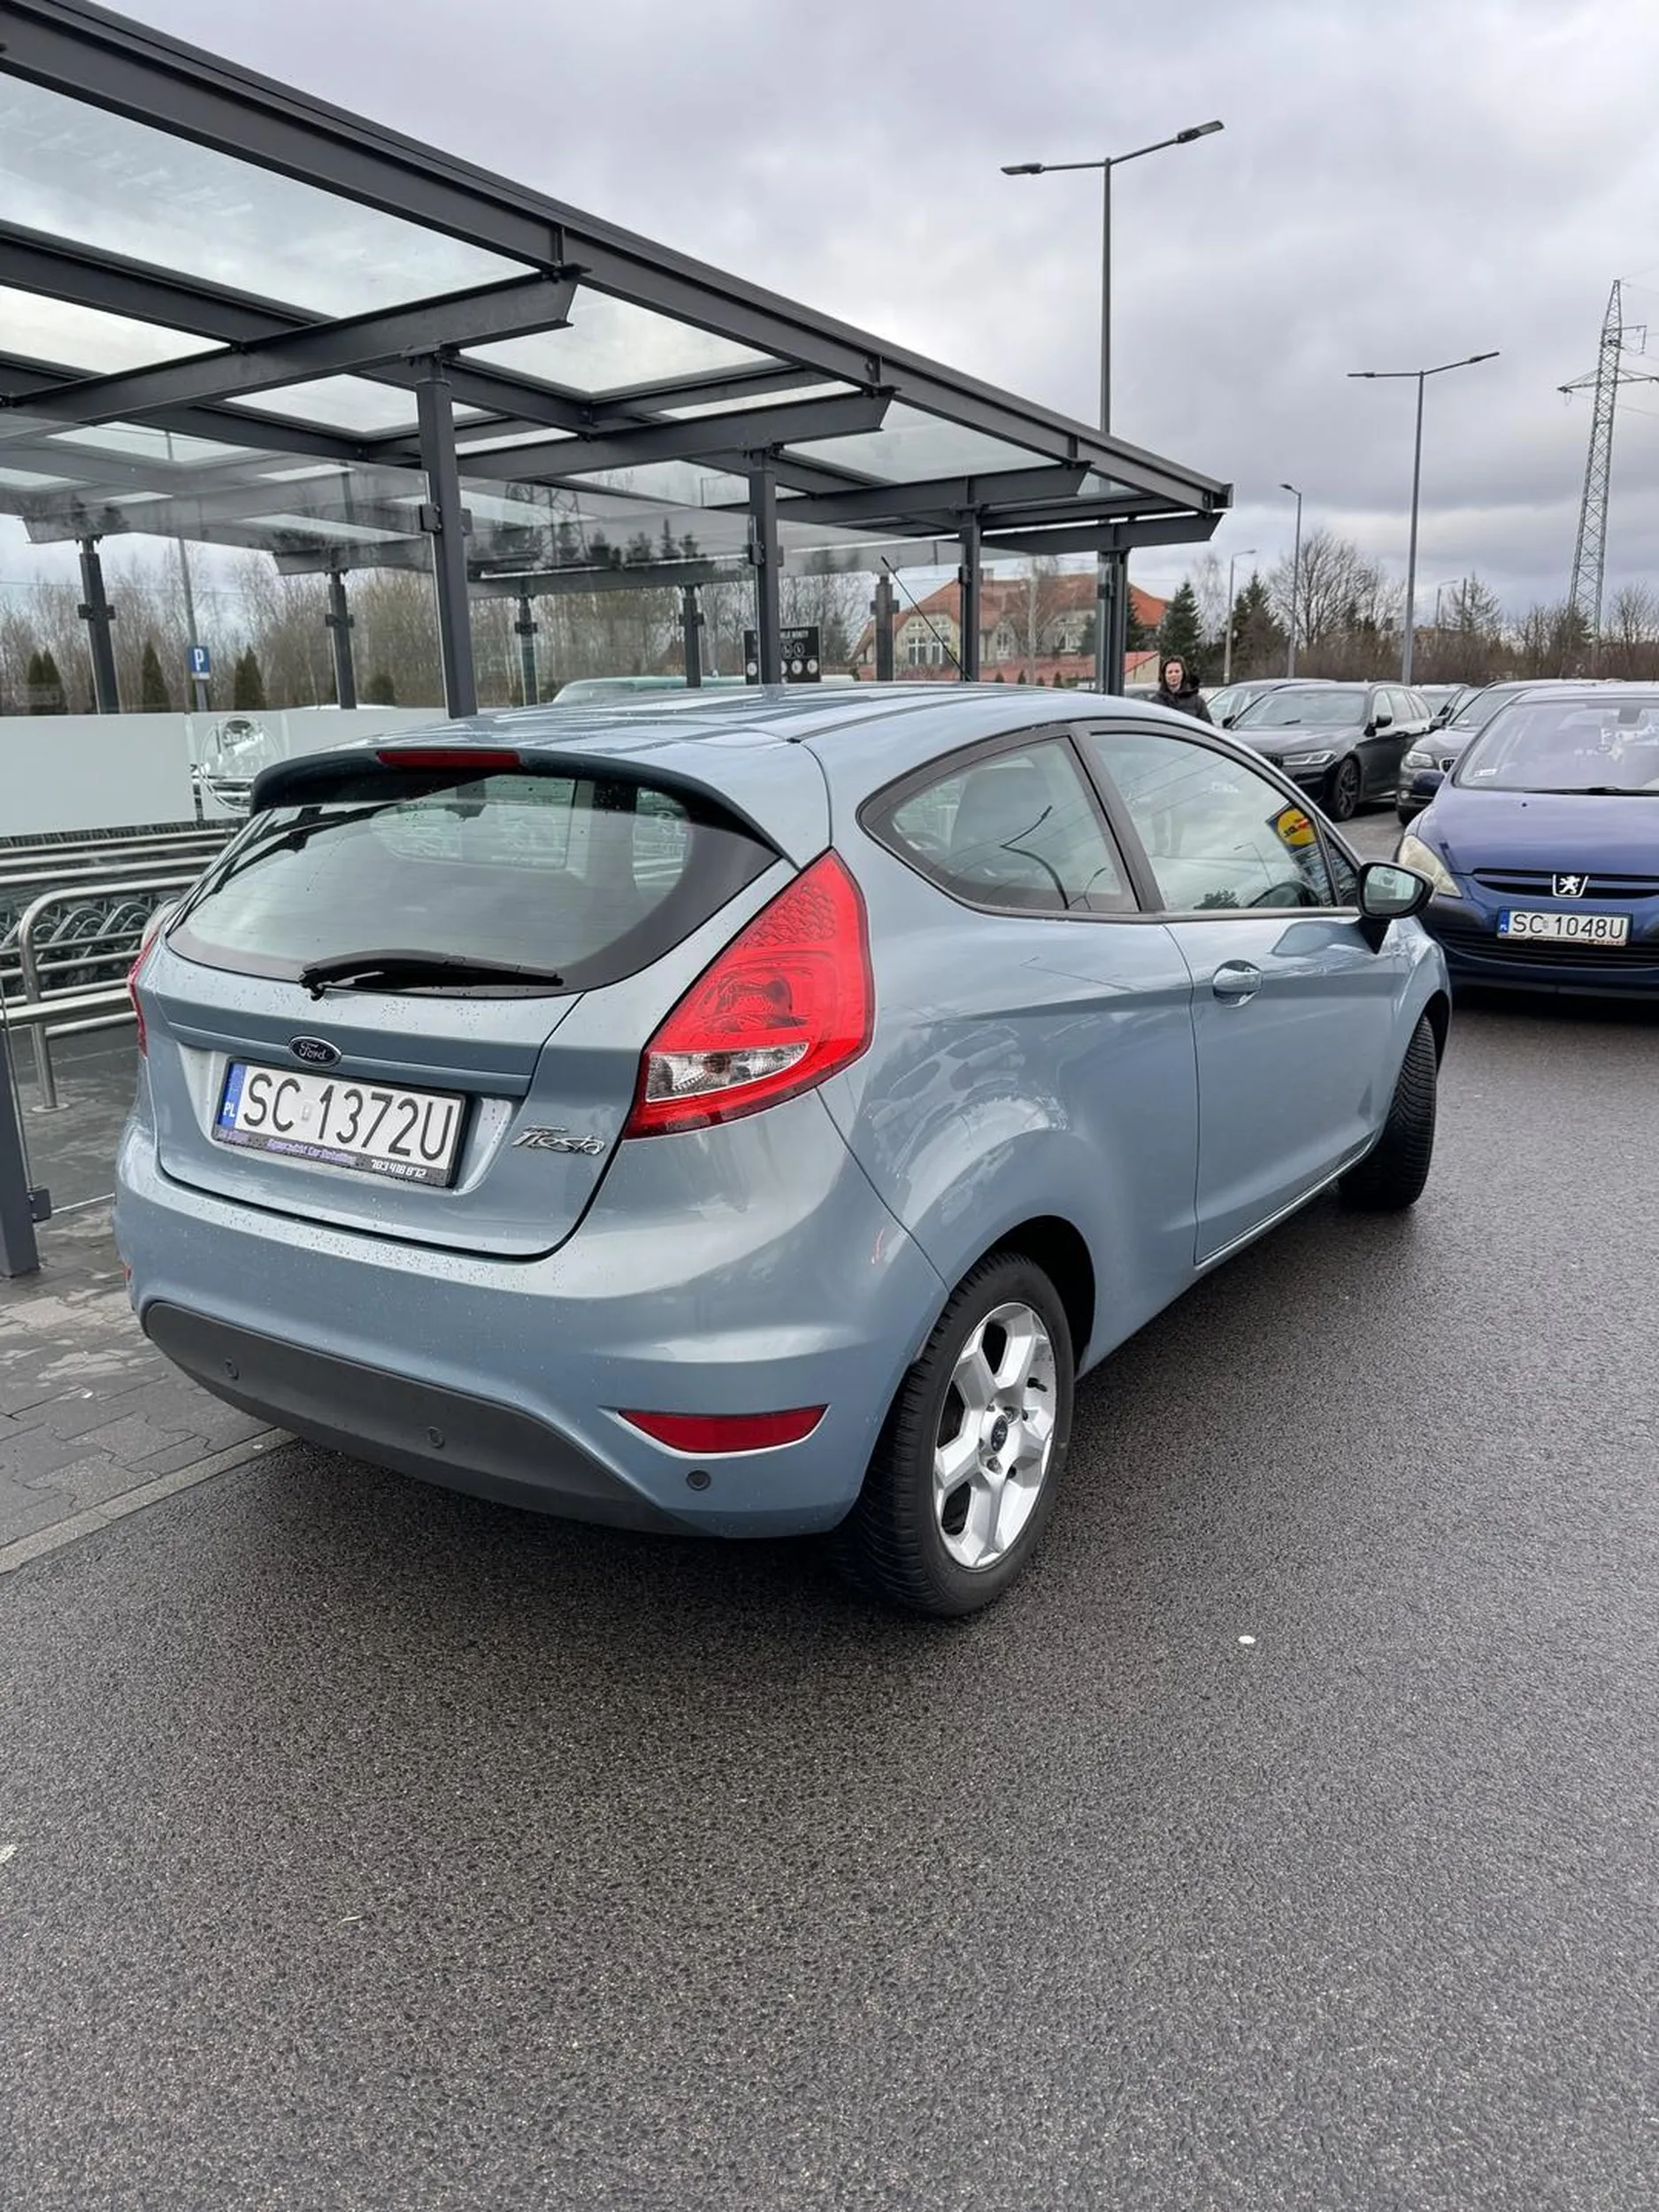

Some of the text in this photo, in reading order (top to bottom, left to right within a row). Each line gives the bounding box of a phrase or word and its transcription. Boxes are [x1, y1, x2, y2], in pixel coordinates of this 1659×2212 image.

[194, 649, 204, 672] P
[1512, 914, 1624, 939] SC 1048U
[299, 1041, 327, 1061] Ford
[222, 1101, 236, 1118] PL
[243, 1072, 454, 1161] SC 1372U
[511, 1125, 605, 1156] Fiesta
